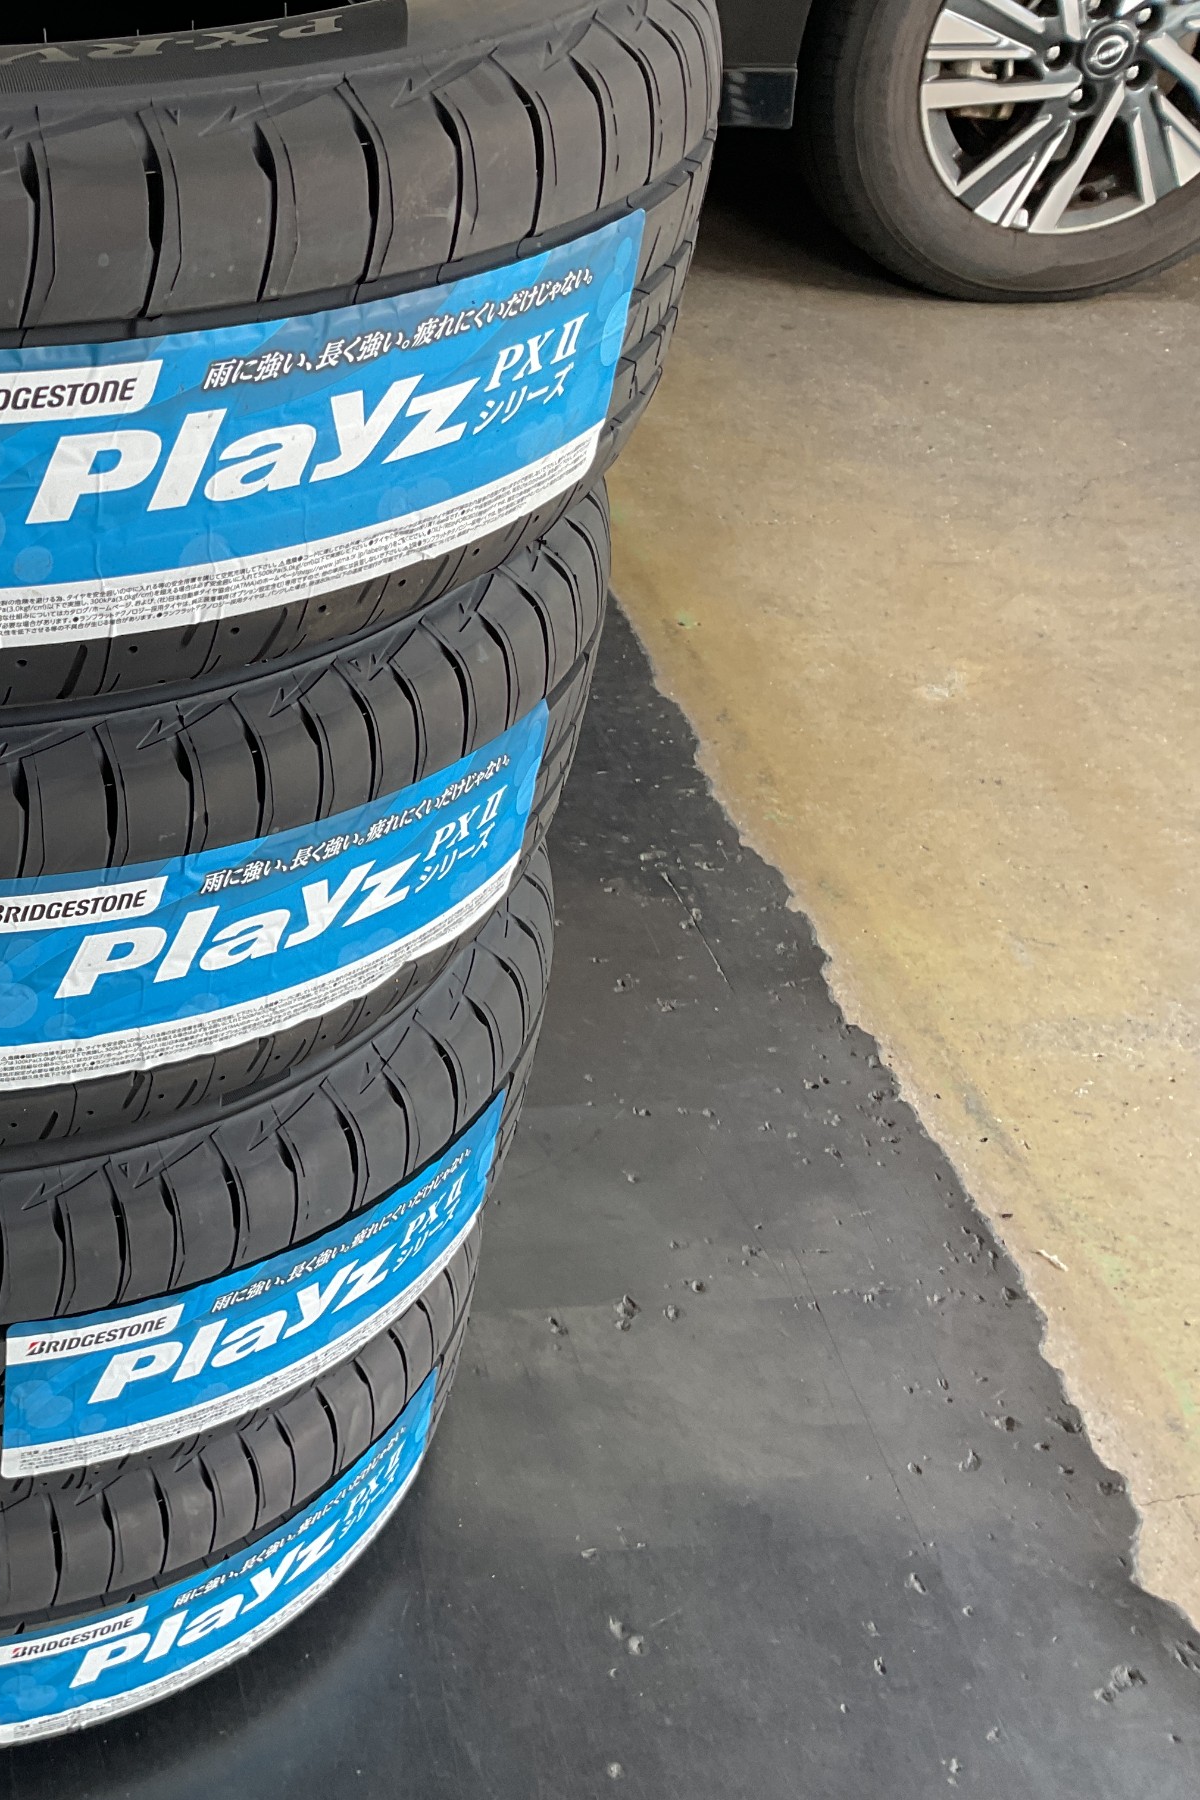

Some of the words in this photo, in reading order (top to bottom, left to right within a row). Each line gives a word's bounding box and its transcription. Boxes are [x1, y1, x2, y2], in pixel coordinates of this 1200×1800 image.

[483, 328, 556, 393] PX
[472, 361, 576, 436] シリーズ
[24, 373, 481, 526] Playz
[414, 820, 495, 894] シリーズ
[422, 804, 481, 862] PX
[53, 852, 422, 999] Playz
[392, 1197, 461, 1273] シリーズ
[399, 1191, 447, 1249] PX
[25, 1315, 167, 1357] BRIDGESTONE
[86, 1242, 398, 1404] Playz
[9, 1615, 135, 1660] BRIDGESTONE
[69, 1519, 341, 1690] Playz
